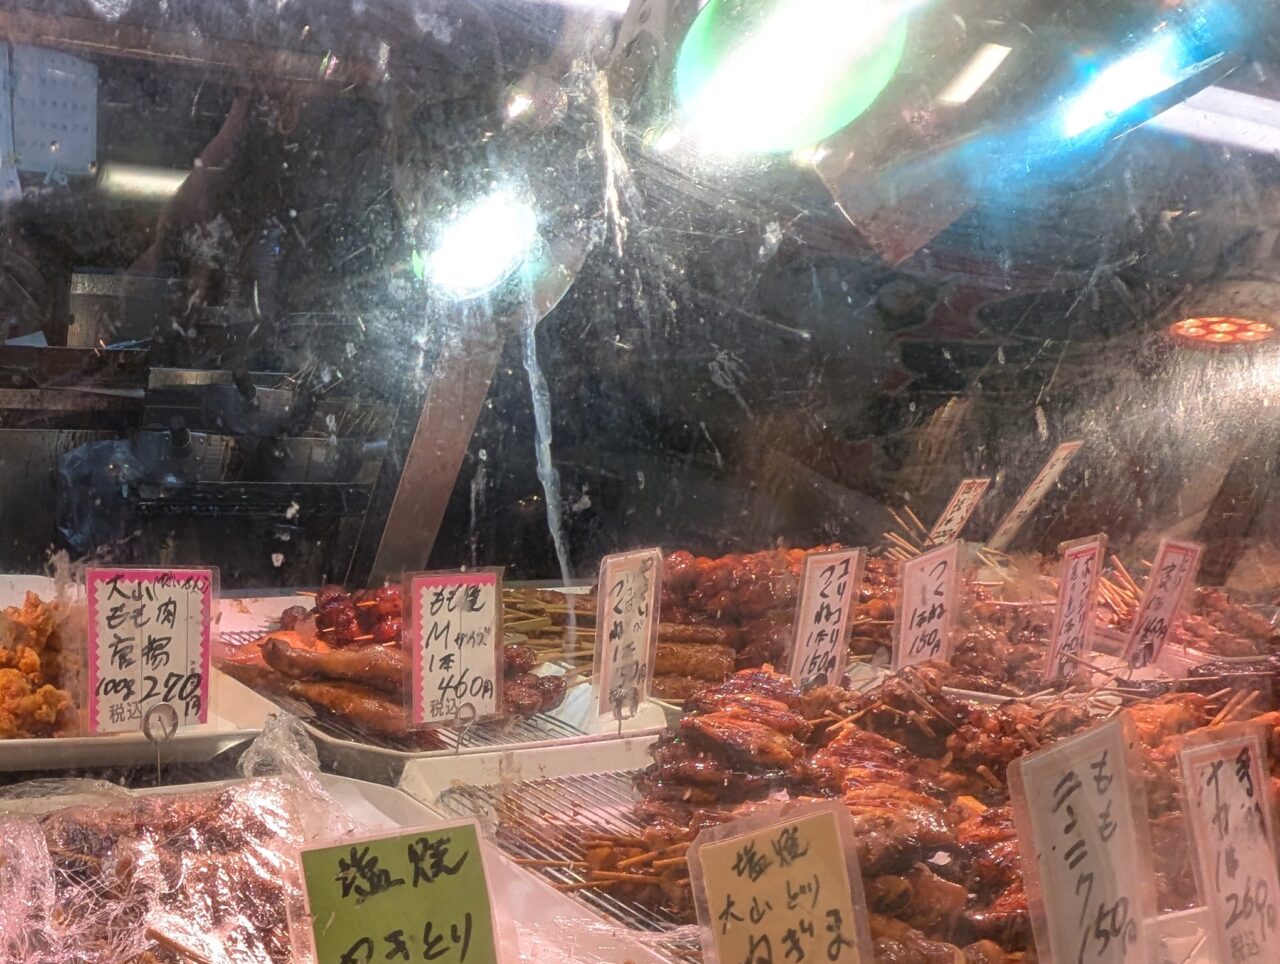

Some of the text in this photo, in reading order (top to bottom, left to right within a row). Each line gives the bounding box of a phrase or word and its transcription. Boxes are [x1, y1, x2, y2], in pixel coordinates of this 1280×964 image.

[430, 584, 486, 616] もも焼
[814, 564, 836, 624] つくね
[927, 560, 948, 624] つくね
[106, 597, 177, 629] もも肉
[108, 634, 172, 671] 唐揚
[429, 654, 455, 672] 1本
[438, 668, 494, 701] 460円
[109, 701, 142, 724] 税込
[430, 698, 458, 718] 税込
[1091, 750, 1118, 843] もも
[335, 836, 469, 903] 塩焼
[732, 826, 810, 883] 塩焼
